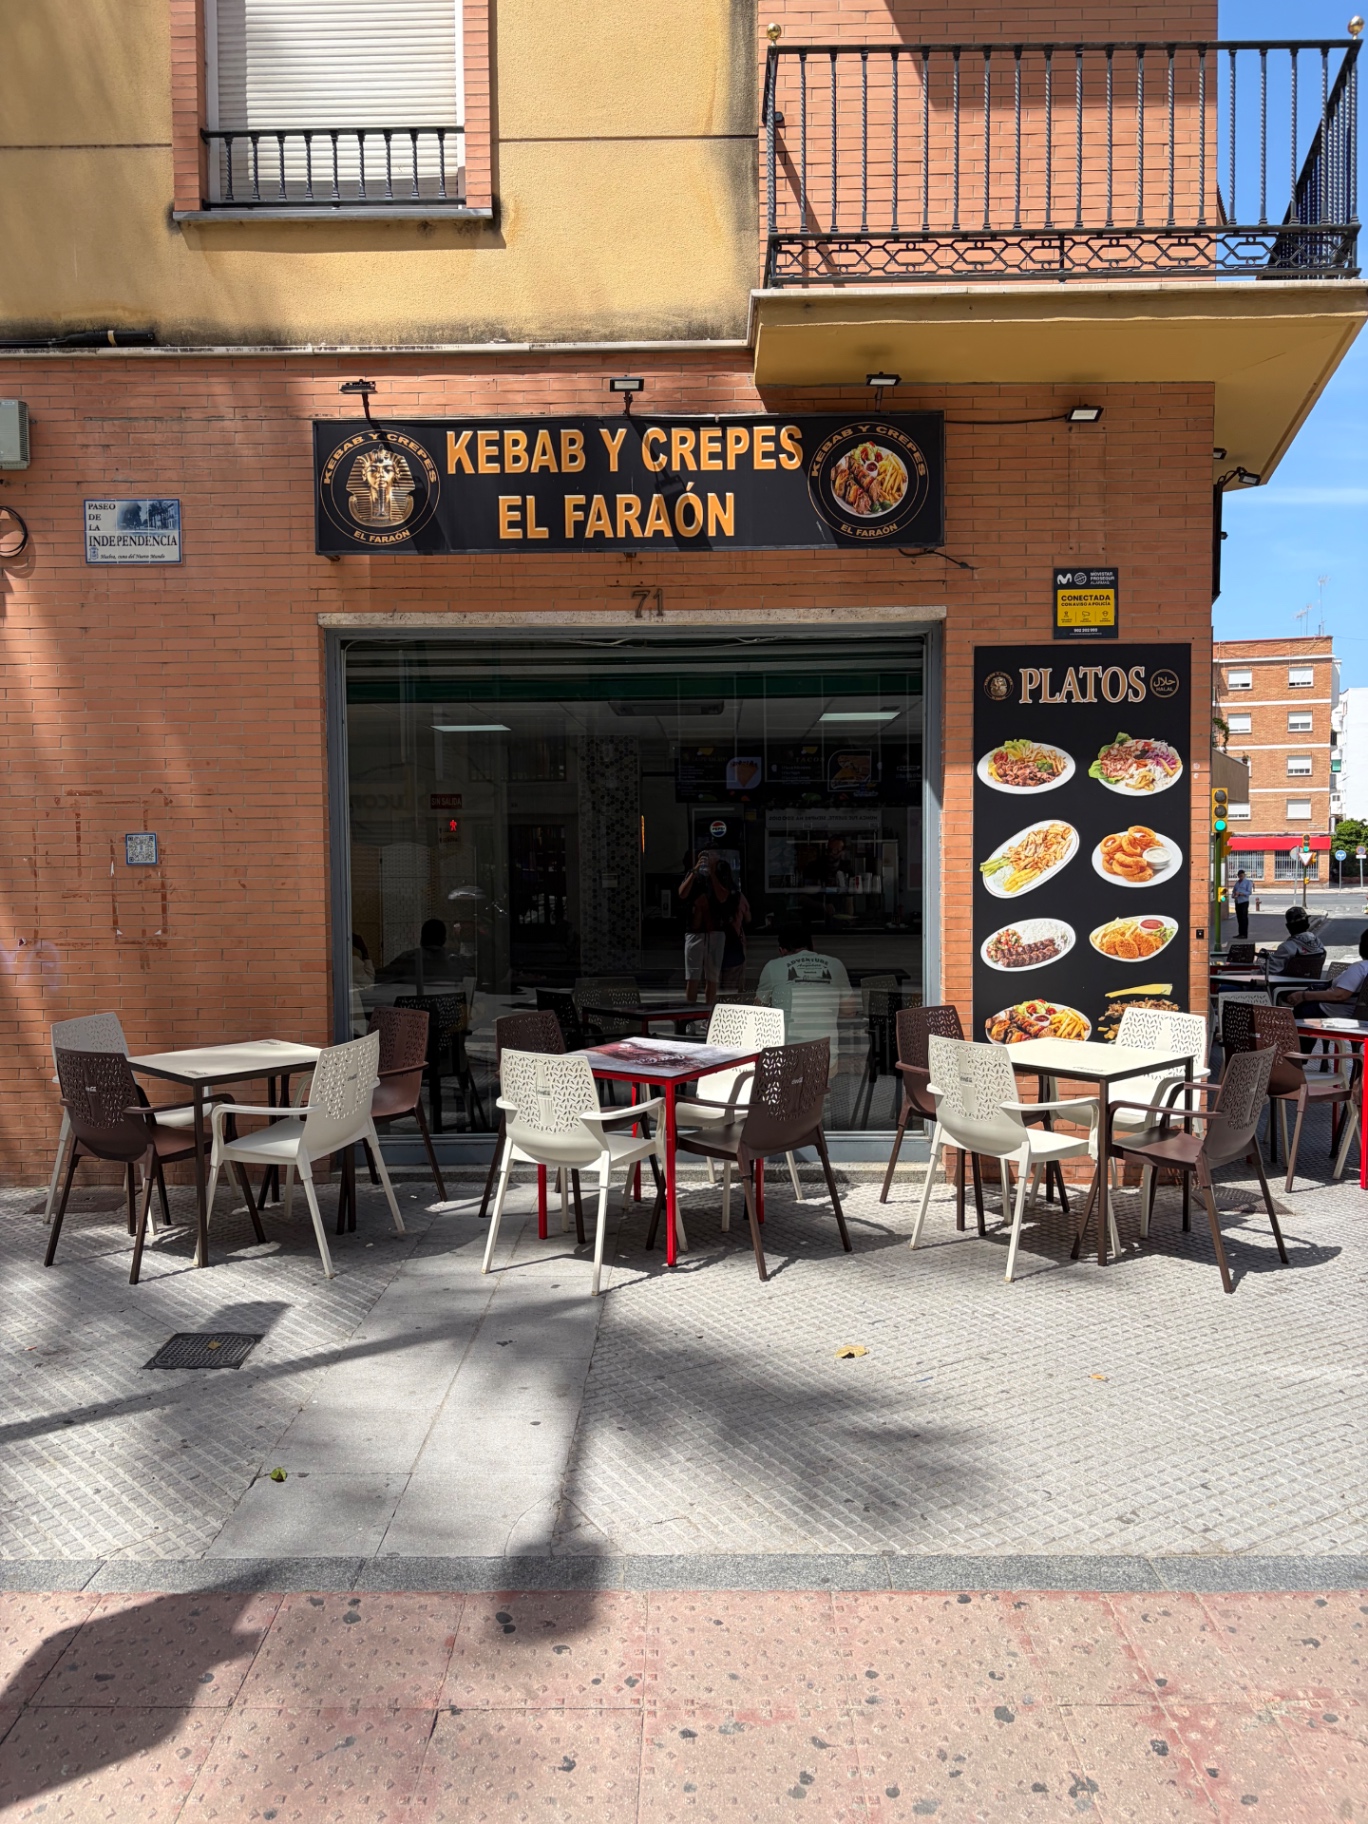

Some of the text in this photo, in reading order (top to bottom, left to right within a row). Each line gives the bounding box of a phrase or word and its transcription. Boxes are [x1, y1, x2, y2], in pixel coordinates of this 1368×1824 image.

[324, 432, 437, 485] KEBAB Y CREPES
[446, 425, 804, 474] KEBAB Y CREPES
[811, 425, 928, 477] KEBAB Y CREPES
[498, 482, 735, 540] EL FARAÓN
[88, 535, 178, 547] INDEPENDENCIA
[353, 529, 411, 543] EL FARAÓN
[840, 523, 898, 537] EL FARAÓN
[631, 588, 664, 618] 71
[1018, 666, 1146, 704] PLATOS
[1154, 676, 1176, 687] حلال
[786, 958, 828, 967] ADVENTURE
